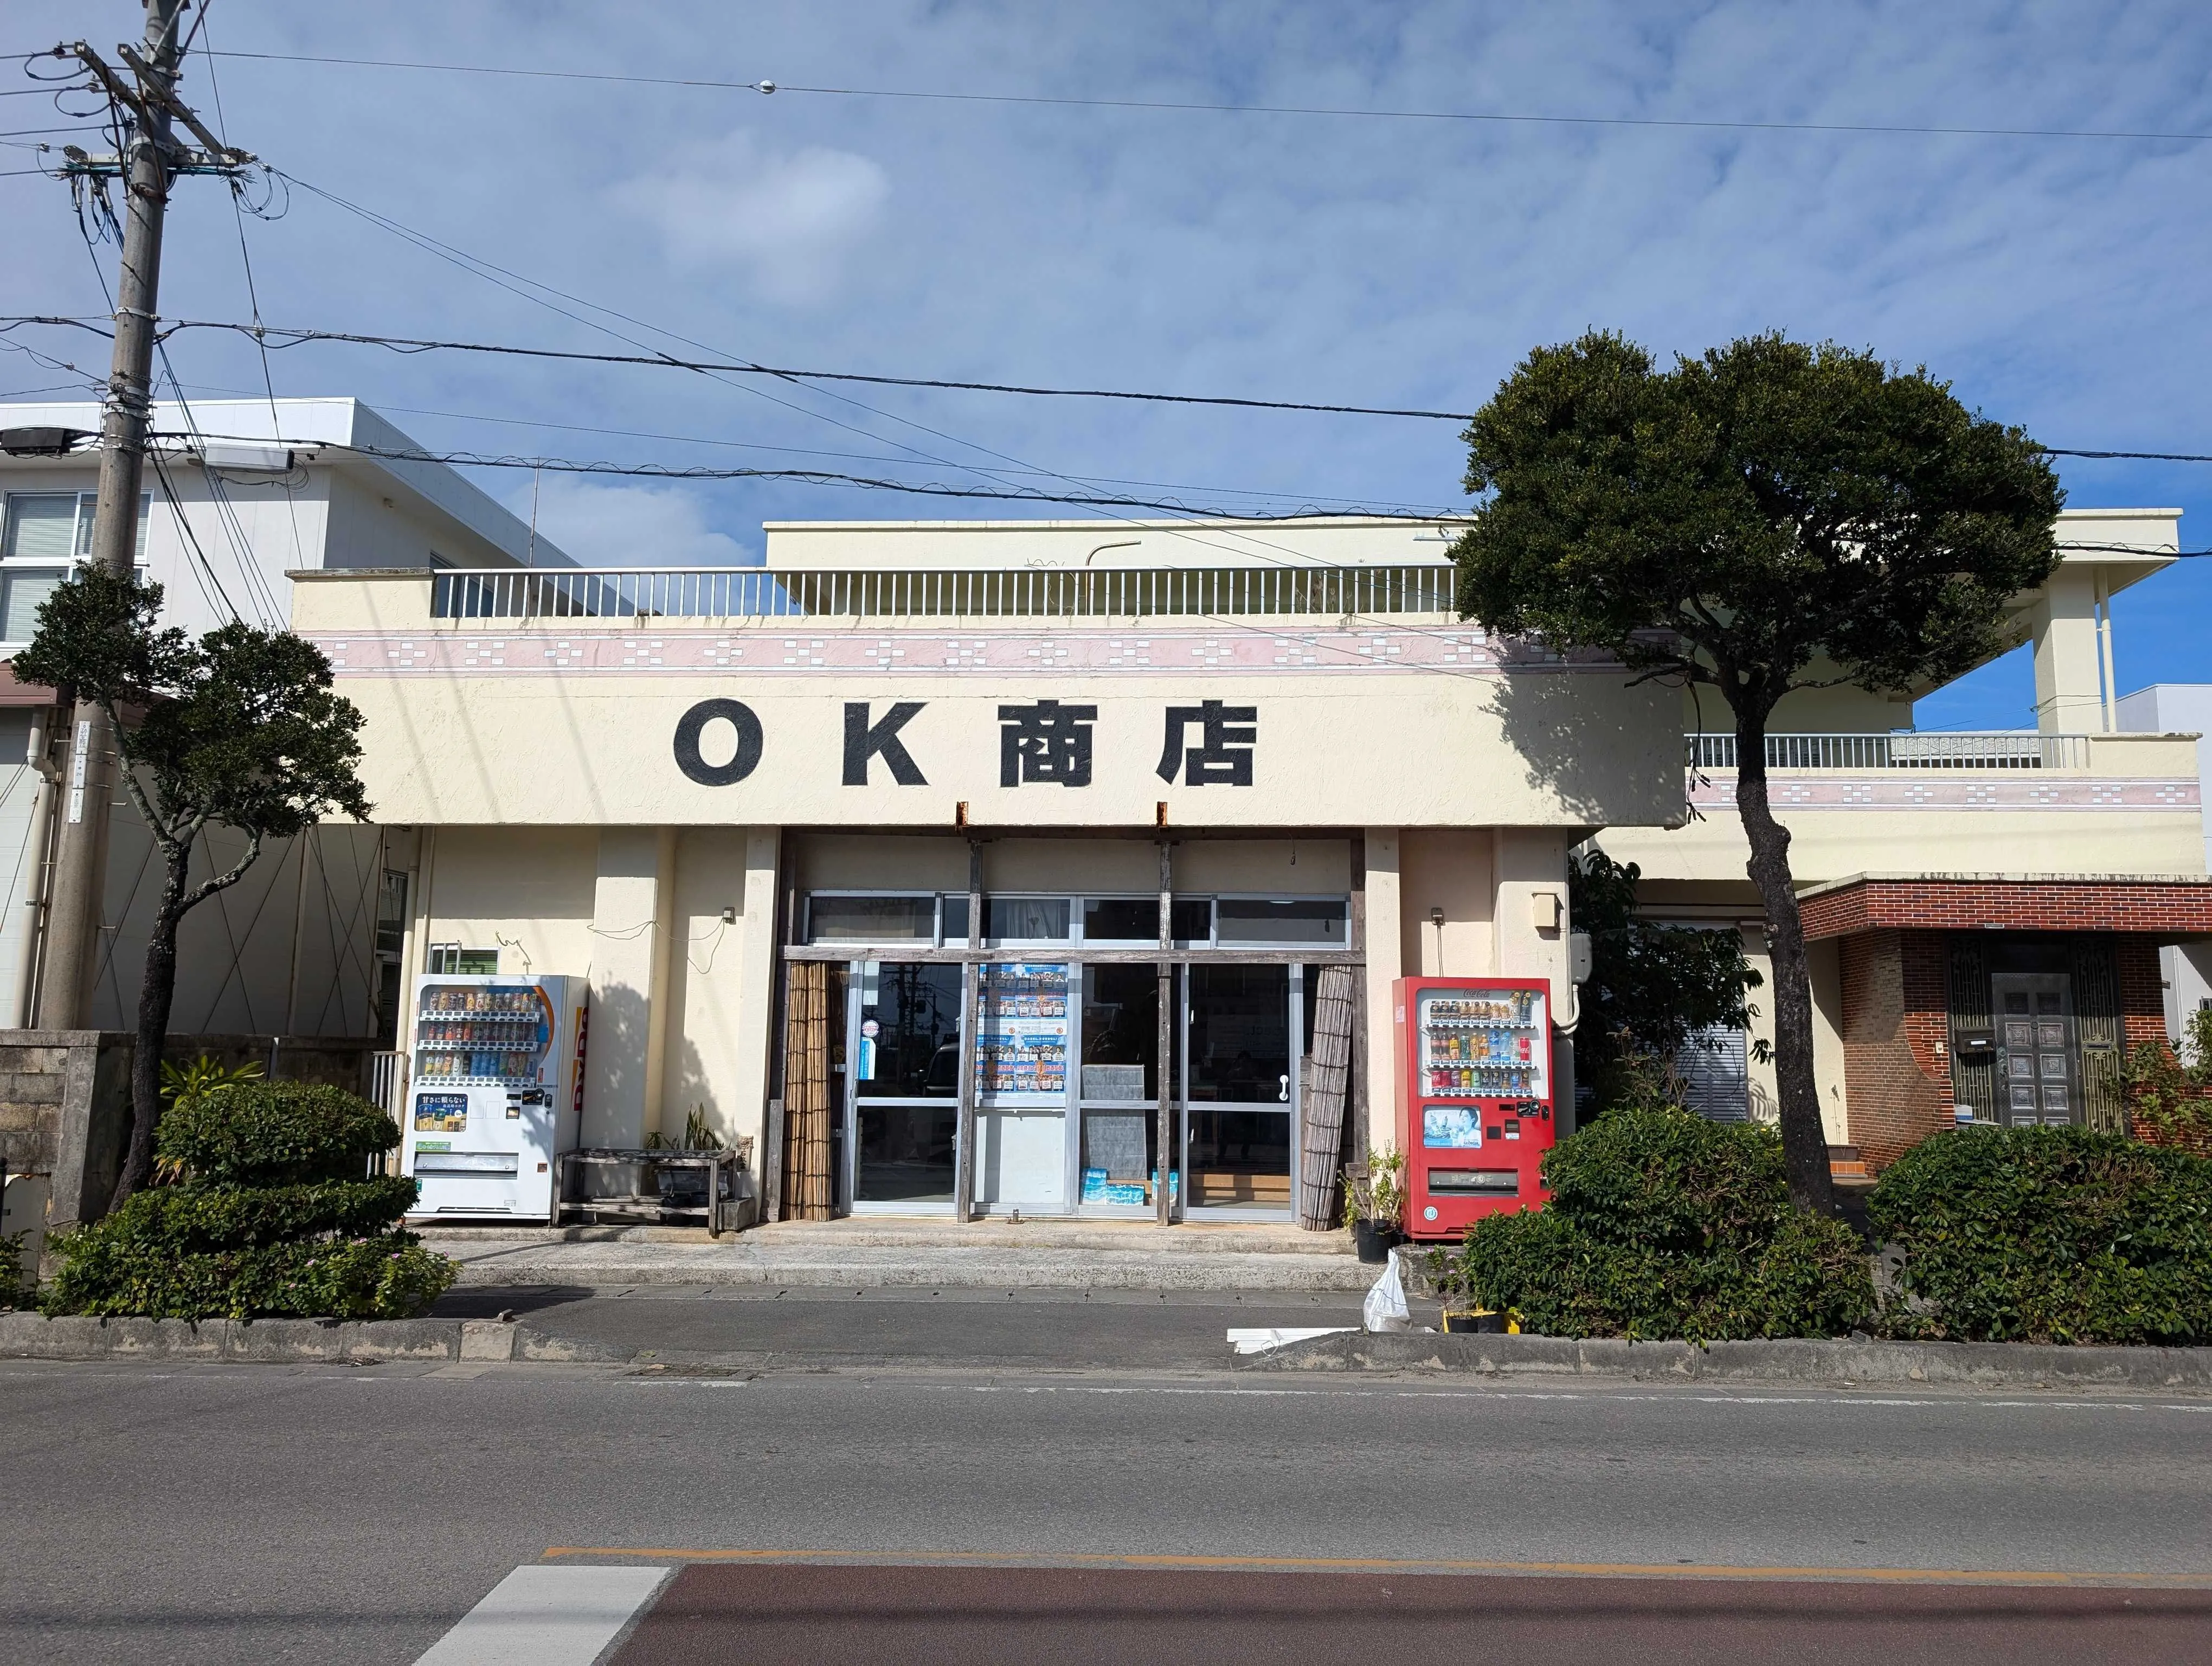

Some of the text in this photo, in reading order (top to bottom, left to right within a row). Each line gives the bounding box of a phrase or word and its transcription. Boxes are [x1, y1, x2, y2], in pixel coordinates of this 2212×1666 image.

[1463, 989, 1490, 998] Coca-Cola
[422, 1095, 465, 1104] 甘さに頼らない
